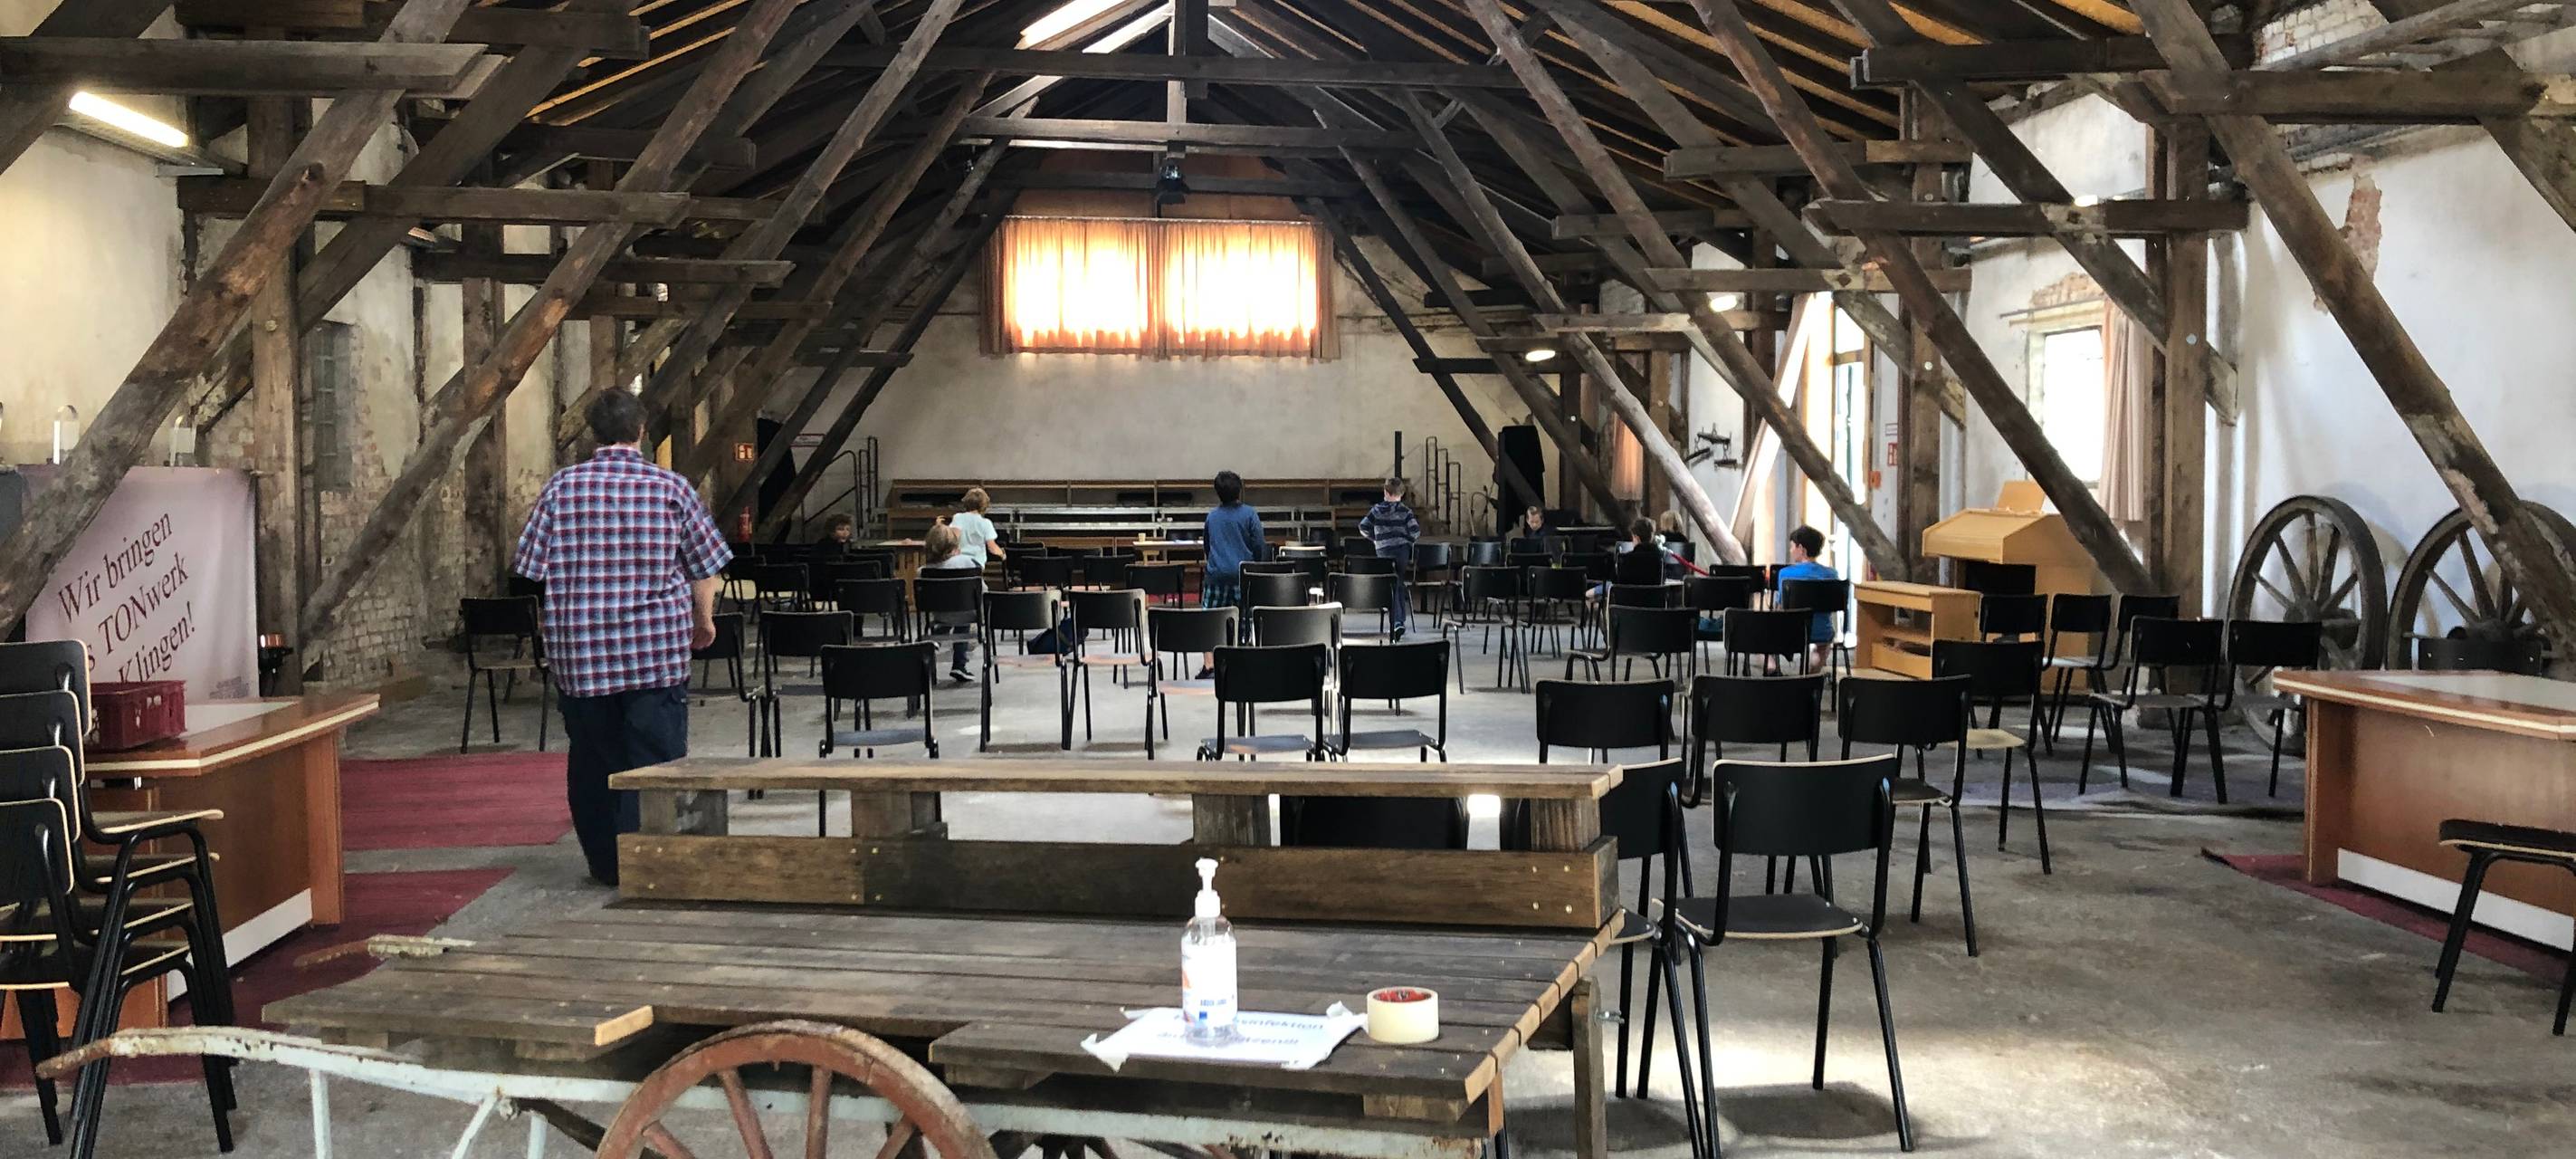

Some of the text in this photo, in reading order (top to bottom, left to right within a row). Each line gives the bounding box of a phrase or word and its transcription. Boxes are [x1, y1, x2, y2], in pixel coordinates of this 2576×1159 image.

[58, 512, 173, 623] Wir bringen
[98, 552, 189, 655] TONwerk
